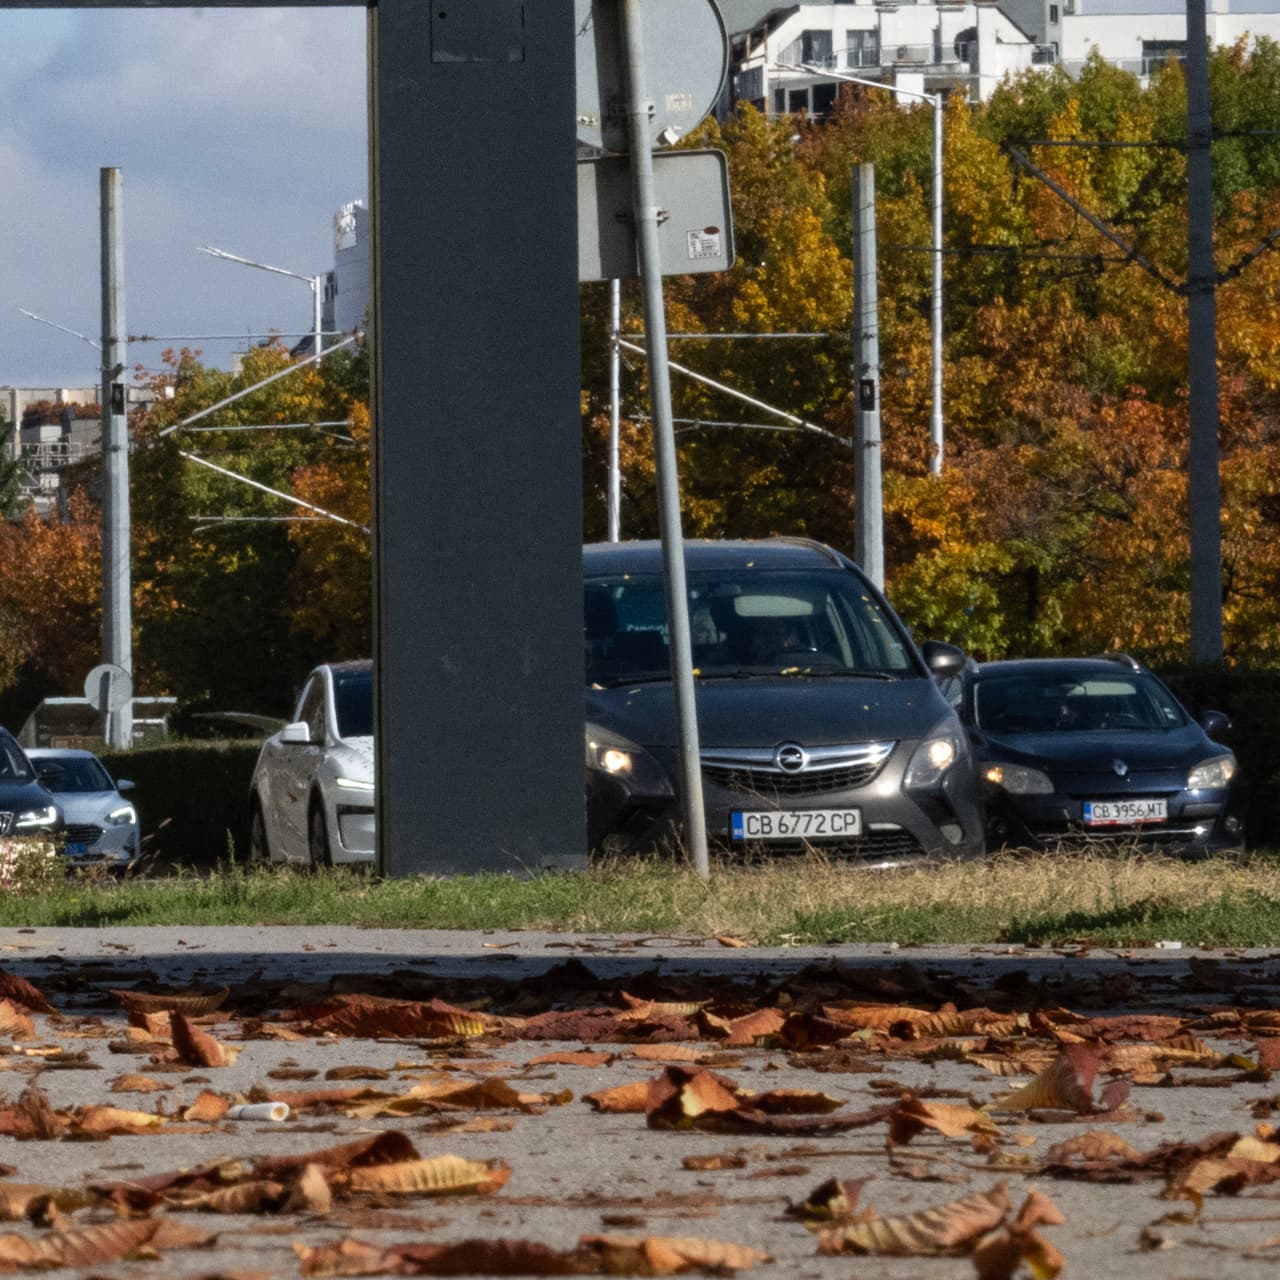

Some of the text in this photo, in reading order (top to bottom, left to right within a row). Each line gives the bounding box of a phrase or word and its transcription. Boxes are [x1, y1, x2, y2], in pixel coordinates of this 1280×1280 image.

[1113, 803, 1145, 817] 3956
[746, 812, 856, 835] CB 6772 CP
